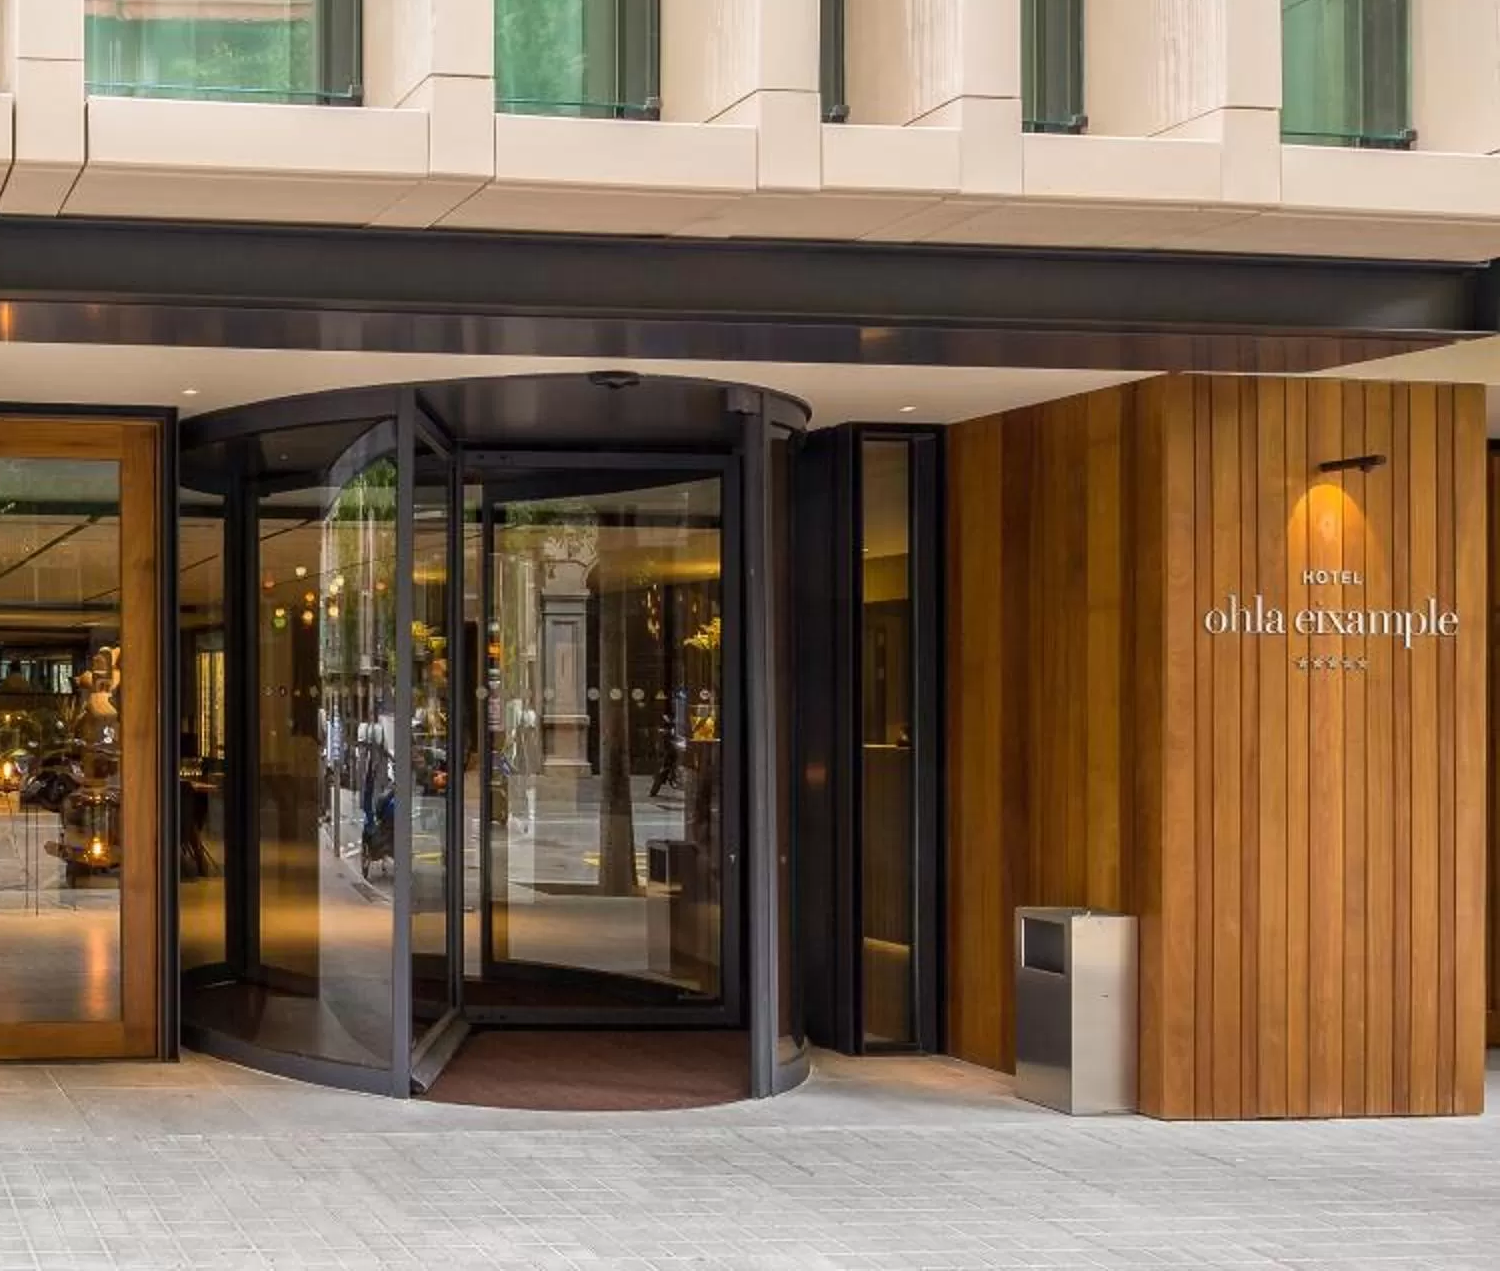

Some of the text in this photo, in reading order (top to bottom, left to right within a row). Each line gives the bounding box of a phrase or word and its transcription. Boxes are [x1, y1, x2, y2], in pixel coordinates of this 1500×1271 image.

[1303, 570, 1363, 585] HOTEL
[1204, 593, 1459, 649] ohla eixample
